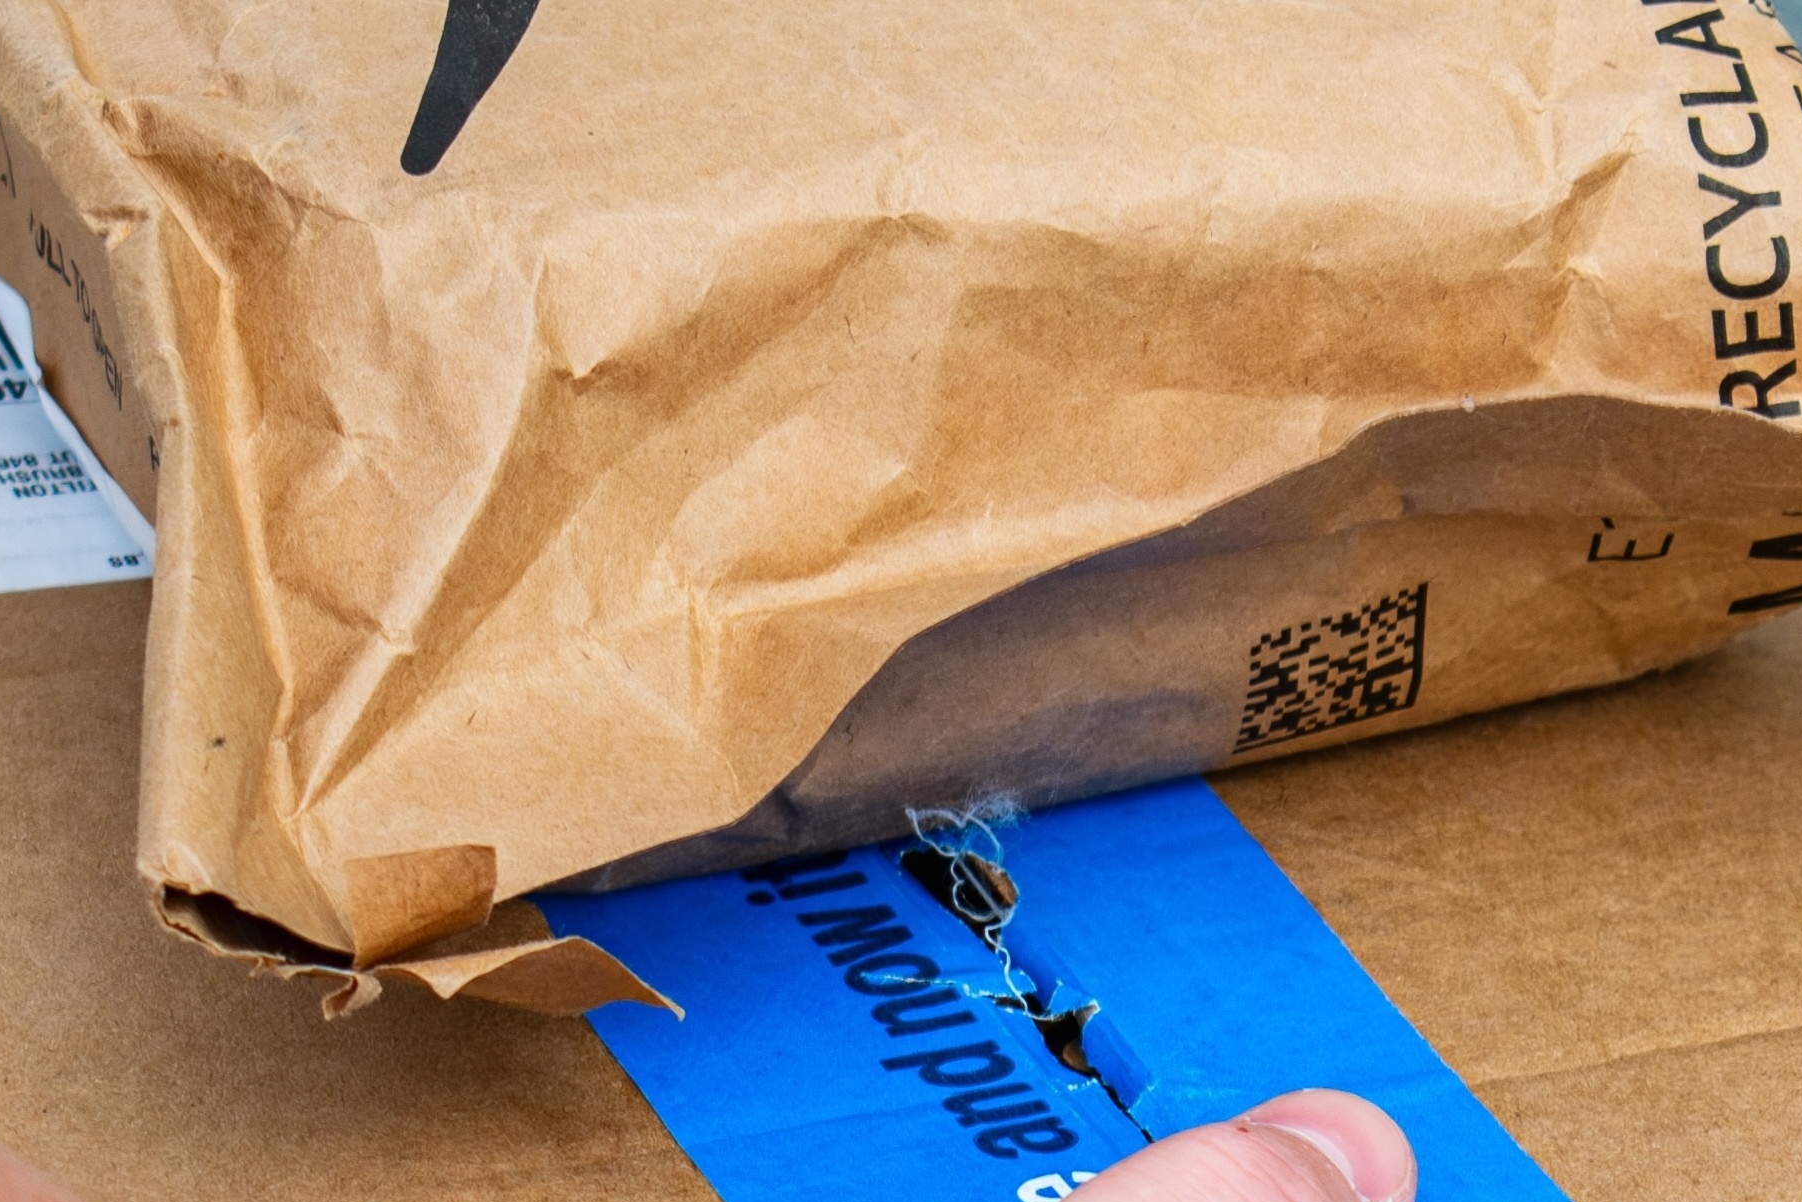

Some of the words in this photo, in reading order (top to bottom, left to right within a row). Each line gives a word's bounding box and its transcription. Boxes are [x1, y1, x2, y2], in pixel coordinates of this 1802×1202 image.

[28, 208, 73, 289] ULL
[1642, 0, 1802, 420] RECYCLA
[108, 551, 143, 569] BS
[796, 904, 978, 1038] now
[879, 1040, 1080, 1160] and
